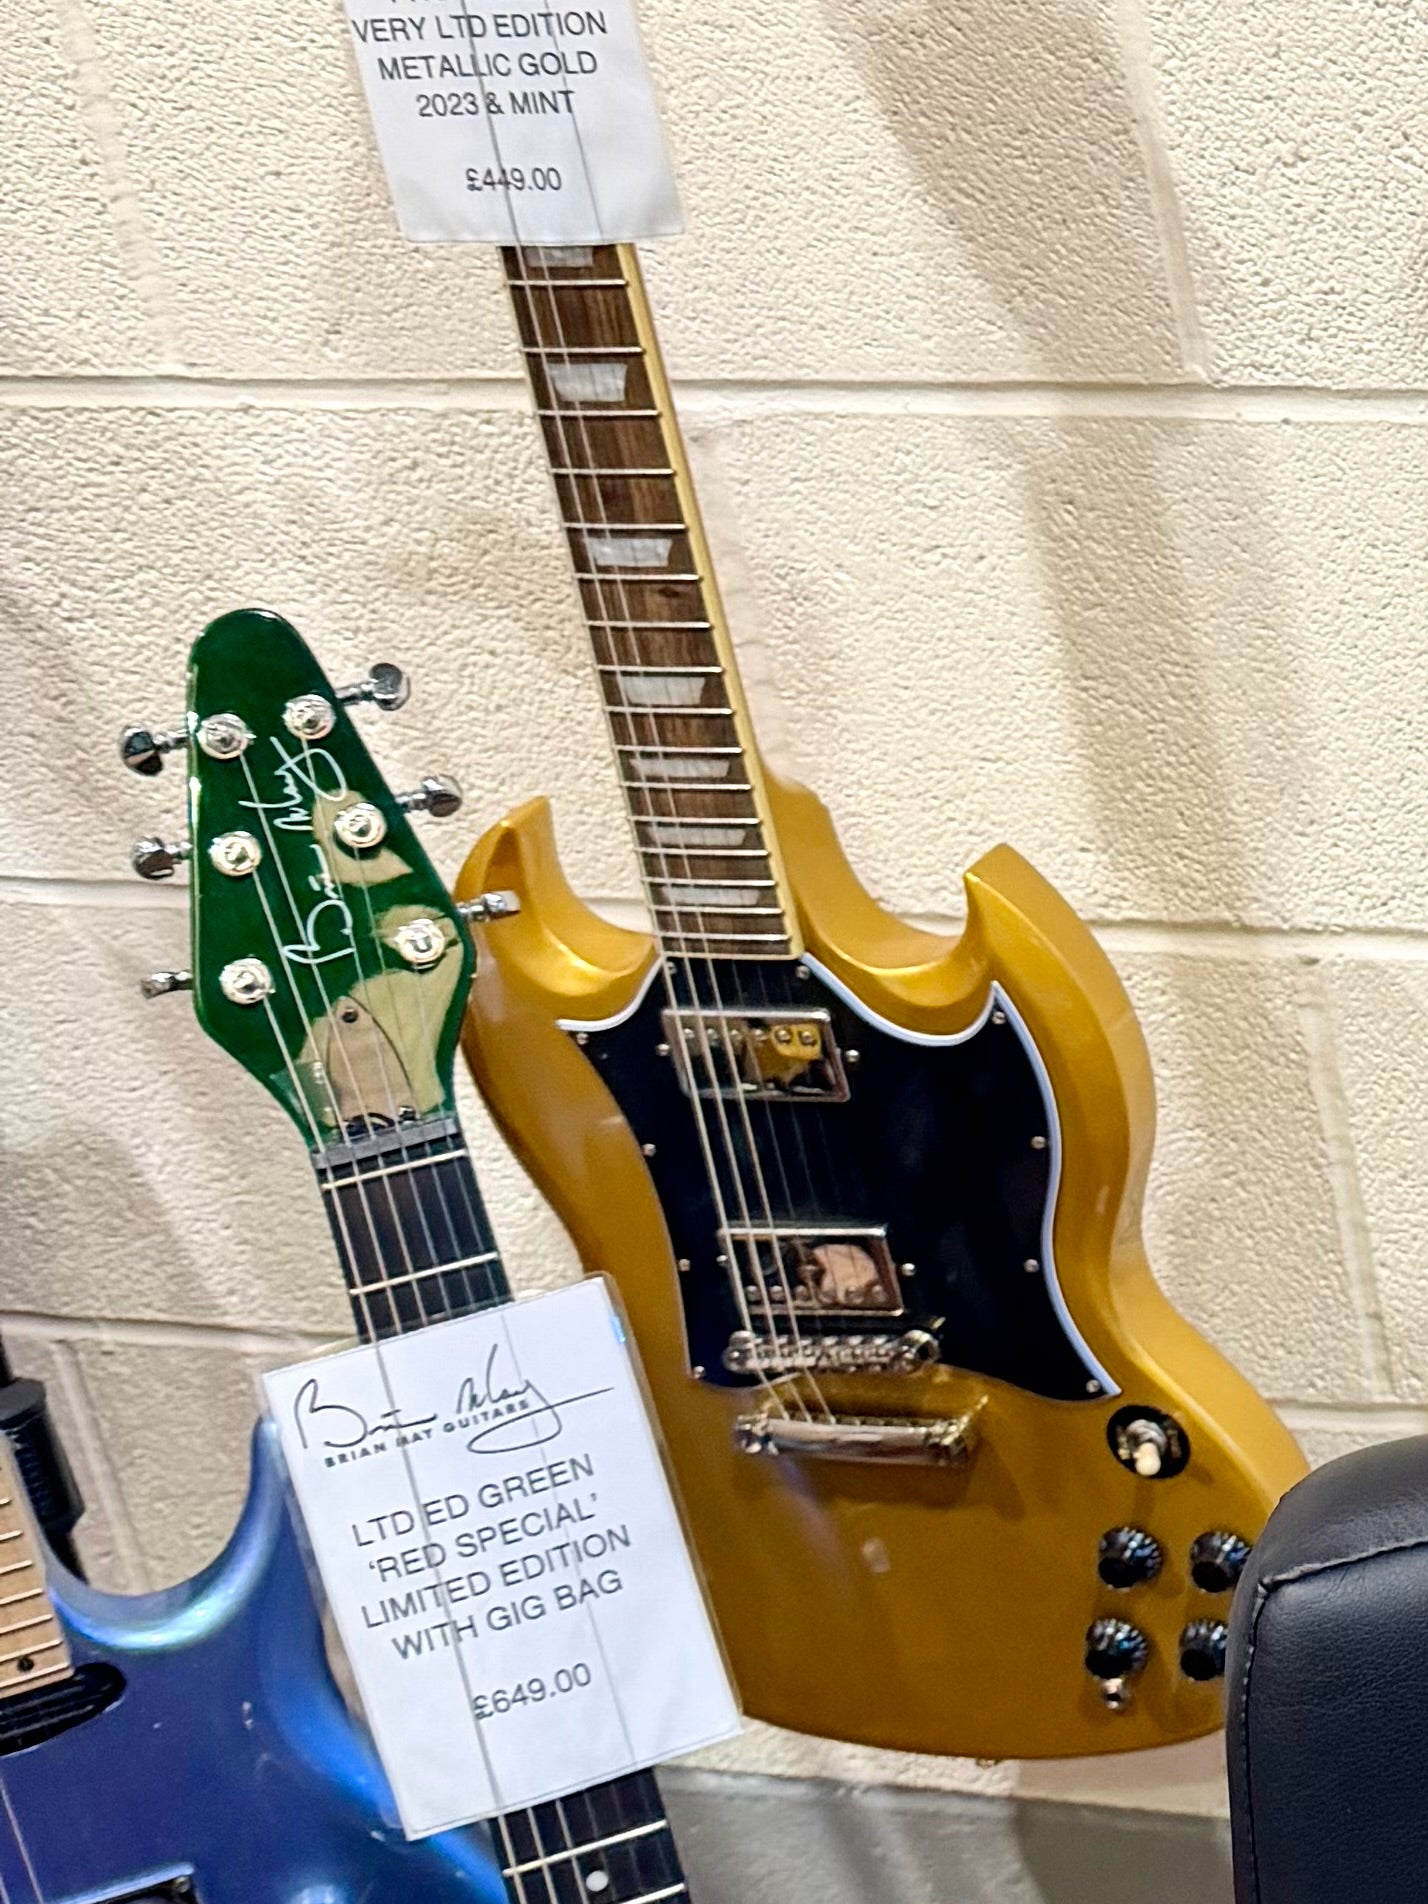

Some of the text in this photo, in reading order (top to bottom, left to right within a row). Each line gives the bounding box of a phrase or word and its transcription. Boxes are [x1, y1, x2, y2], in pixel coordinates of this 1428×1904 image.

[352, 11, 607, 43] VERY LTD EDITION
[378, 51, 597, 80] METALLIC GOLD
[418, 90, 575, 117] 2023 & MINT
[466, 167, 561, 192] £449.00
[324, 1442, 387, 1467] BRIAN
[442, 1399, 529, 1433] GUITARS
[352, 1454, 593, 1548] LTD ED GREEN
[361, 1525, 631, 1630] LIMITED EDITION
[392, 1569, 624, 1660] WITH GIG BAG
[473, 1662, 591, 1720] £649.00
